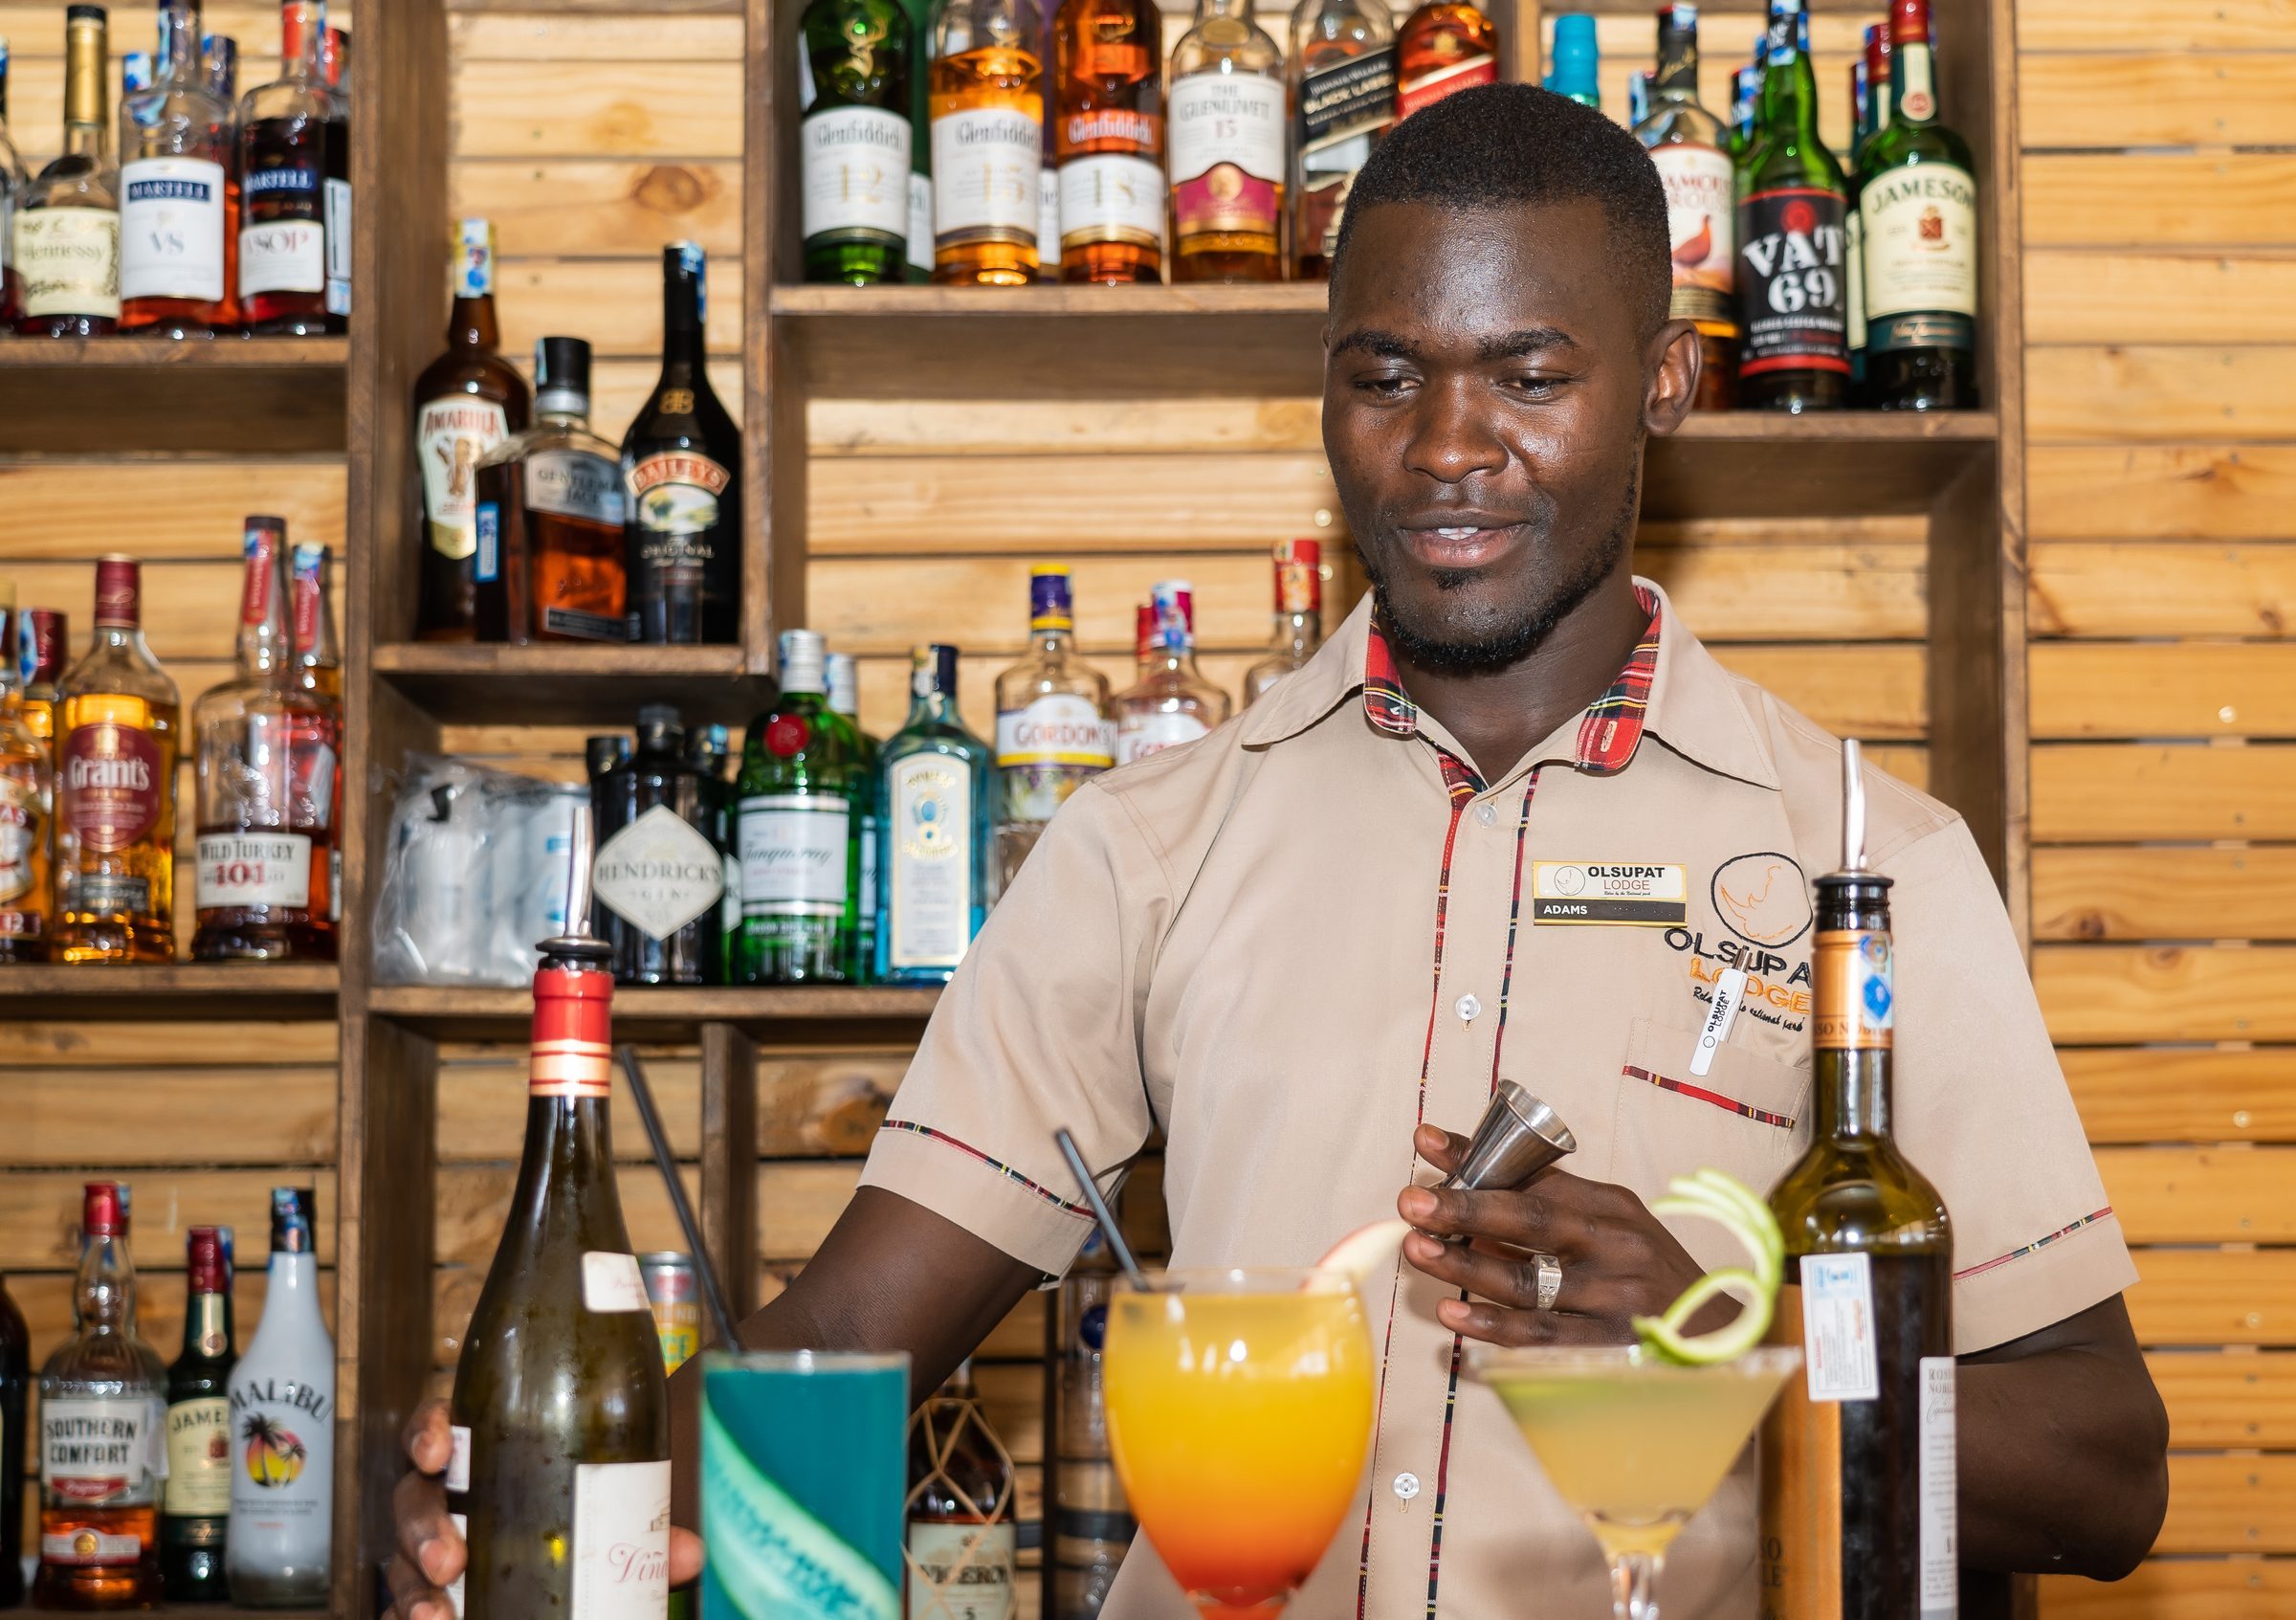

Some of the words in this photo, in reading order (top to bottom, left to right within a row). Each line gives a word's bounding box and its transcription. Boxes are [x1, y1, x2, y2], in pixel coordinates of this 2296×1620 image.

[1872, 178, 1974, 213] JAMESON
[1742, 225, 1845, 277] VAT
[1768, 269, 1836, 314] 69
[70, 754, 150, 791] Grant's
[216, 861, 264, 885] 101
[1588, 866, 1665, 878] OLSUPAT
[1603, 879, 1650, 890] LODGE
[1543, 905, 1588, 915] ADAMS
[1665, 928, 1812, 988] OLSUPA
[1692, 987, 1712, 1005] Rela
[1708, 990, 1727, 1032] OLSUPAT
[1714, 999, 1730, 1027] LODGE
[230, 1378, 332, 1424] MALIBU
[46, 1417, 137, 1440] SOUTHERN
[172, 1407, 226, 1433] JAME
[51, 1442, 129, 1465] COMFORT
